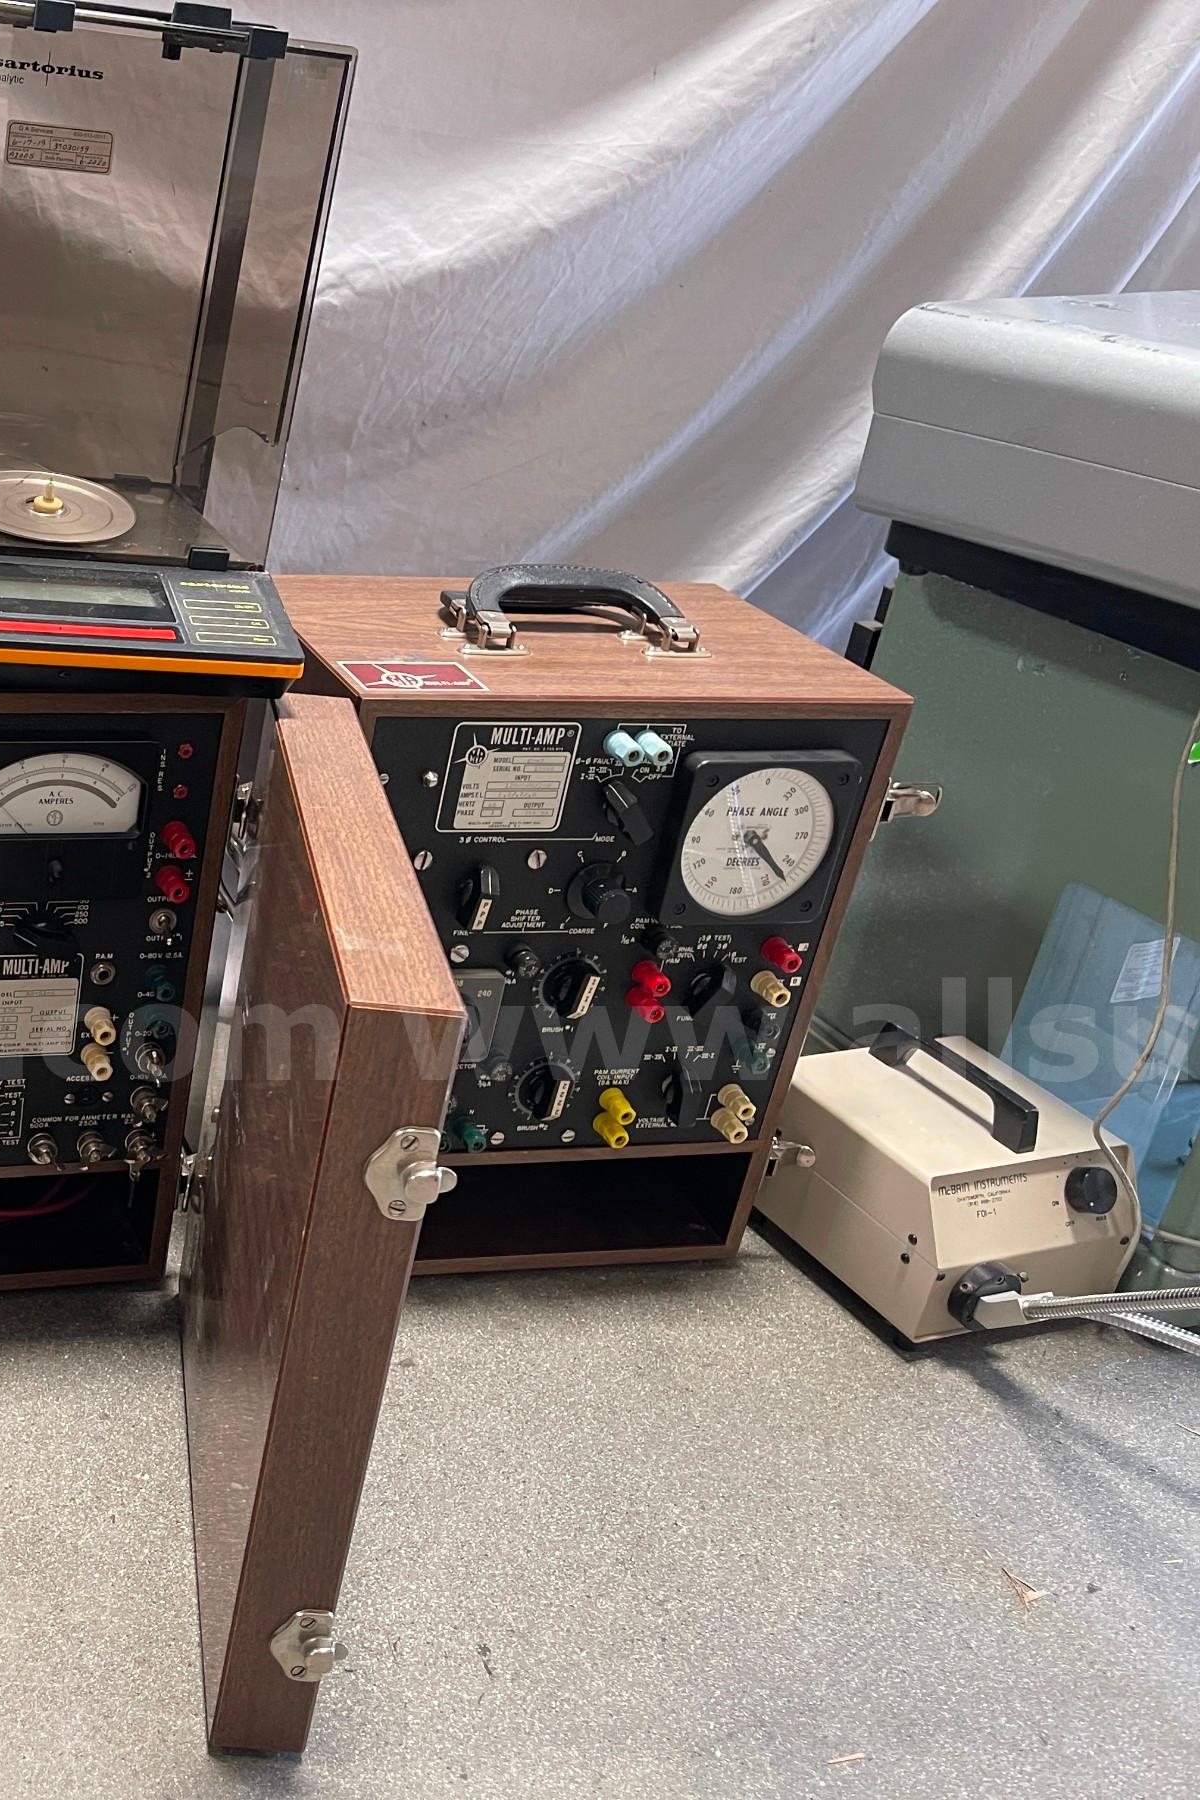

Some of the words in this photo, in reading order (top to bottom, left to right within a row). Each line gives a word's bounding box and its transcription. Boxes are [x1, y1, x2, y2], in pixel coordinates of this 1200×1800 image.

[782, 787, 797, 801] 330
[38, 798, 75, 806] AMPERES
[704, 807, 715, 818] 60
[726, 807, 756, 817] PHASE
[759, 807, 789, 817] ANGLE
[794, 805, 809, 816] 300
[473, 836, 506, 844] CONTROL
[595, 835, 615, 843] MODE
[691, 835, 701, 844] 90
[794, 831, 809, 840] 270
[692, 857, 706, 870] 120
[725, 857, 761, 867] DEGREES
[781, 855, 796, 868] 240
[704, 876, 718, 889] 150
[729, 886, 743, 895] 180
[501, 921, 546, 929] ADJUSTMENT
[714, 934, 730, 942] TEST
[2, 958, 70, 976] MULTI-AMP
[476, 990, 492, 998] 240
[6, 1078, 26, 1086] TEST
[4, 1091, 22, 1099] TEST
[31, 1116, 62, 1124] COMMON
[80, 1113, 118, 1121] AMMETER
[973, 1172, 1028, 1191] INSTRUMENTS
